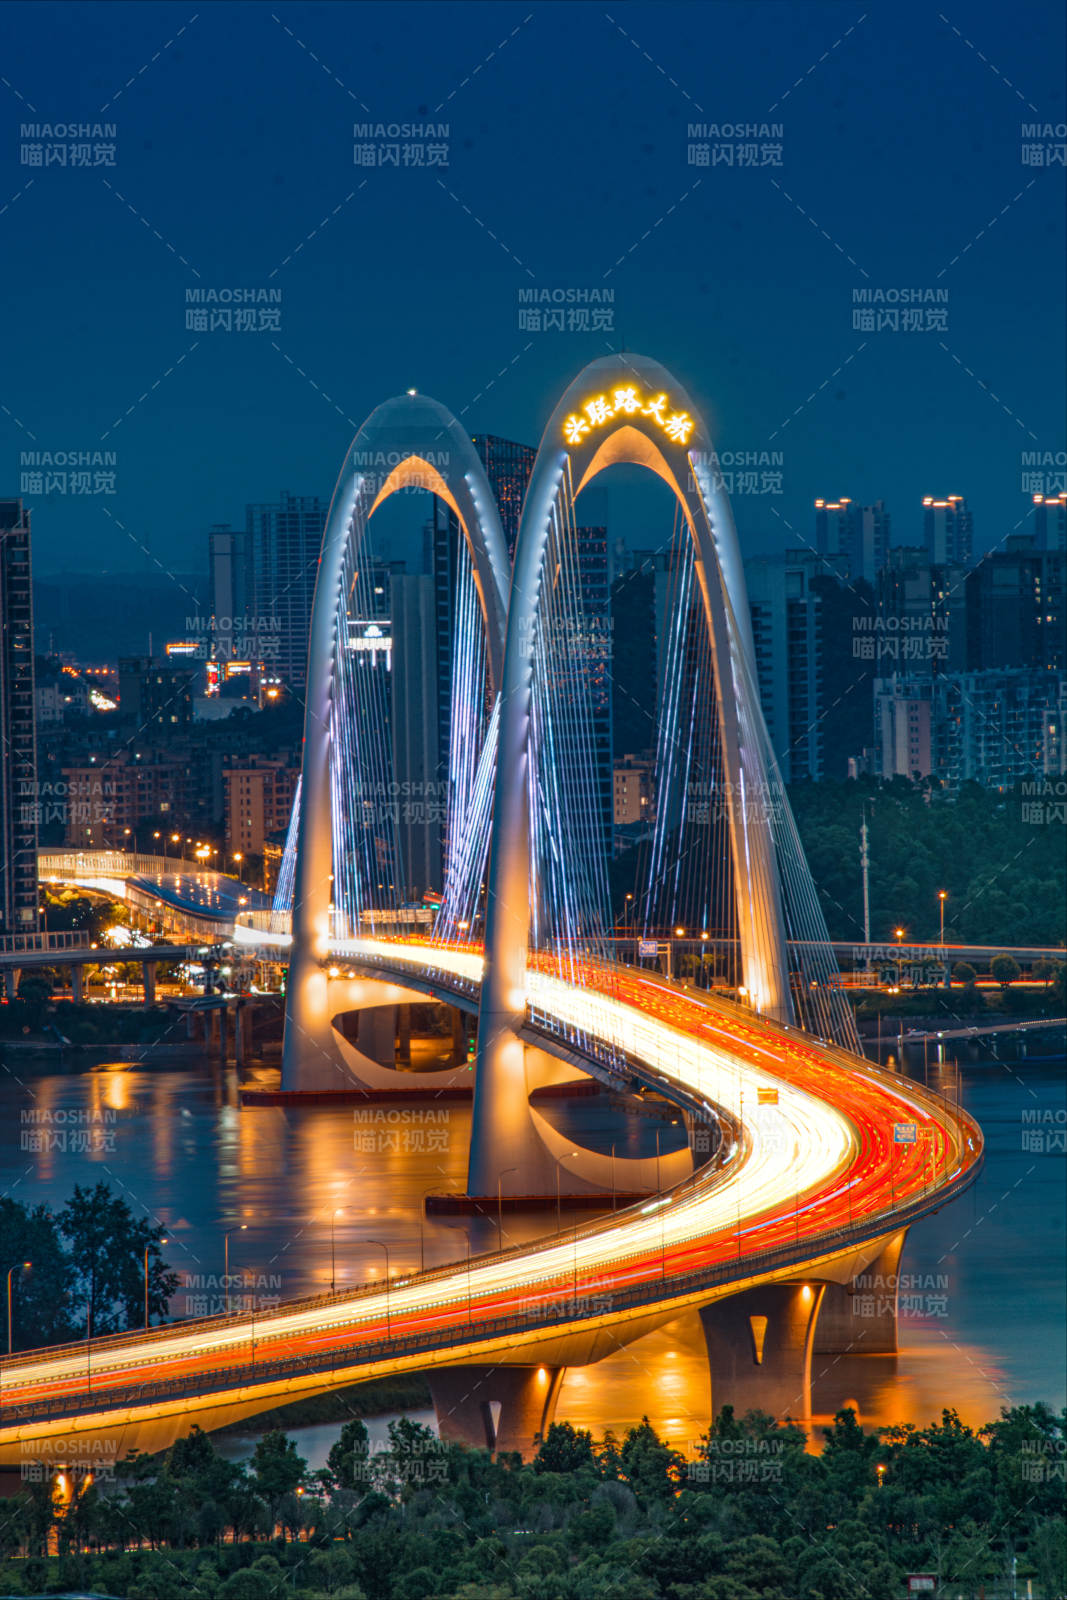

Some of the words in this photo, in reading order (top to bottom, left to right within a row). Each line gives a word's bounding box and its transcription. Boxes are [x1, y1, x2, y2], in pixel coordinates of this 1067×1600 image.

[565, 387, 692, 443] 兴联路大桥
